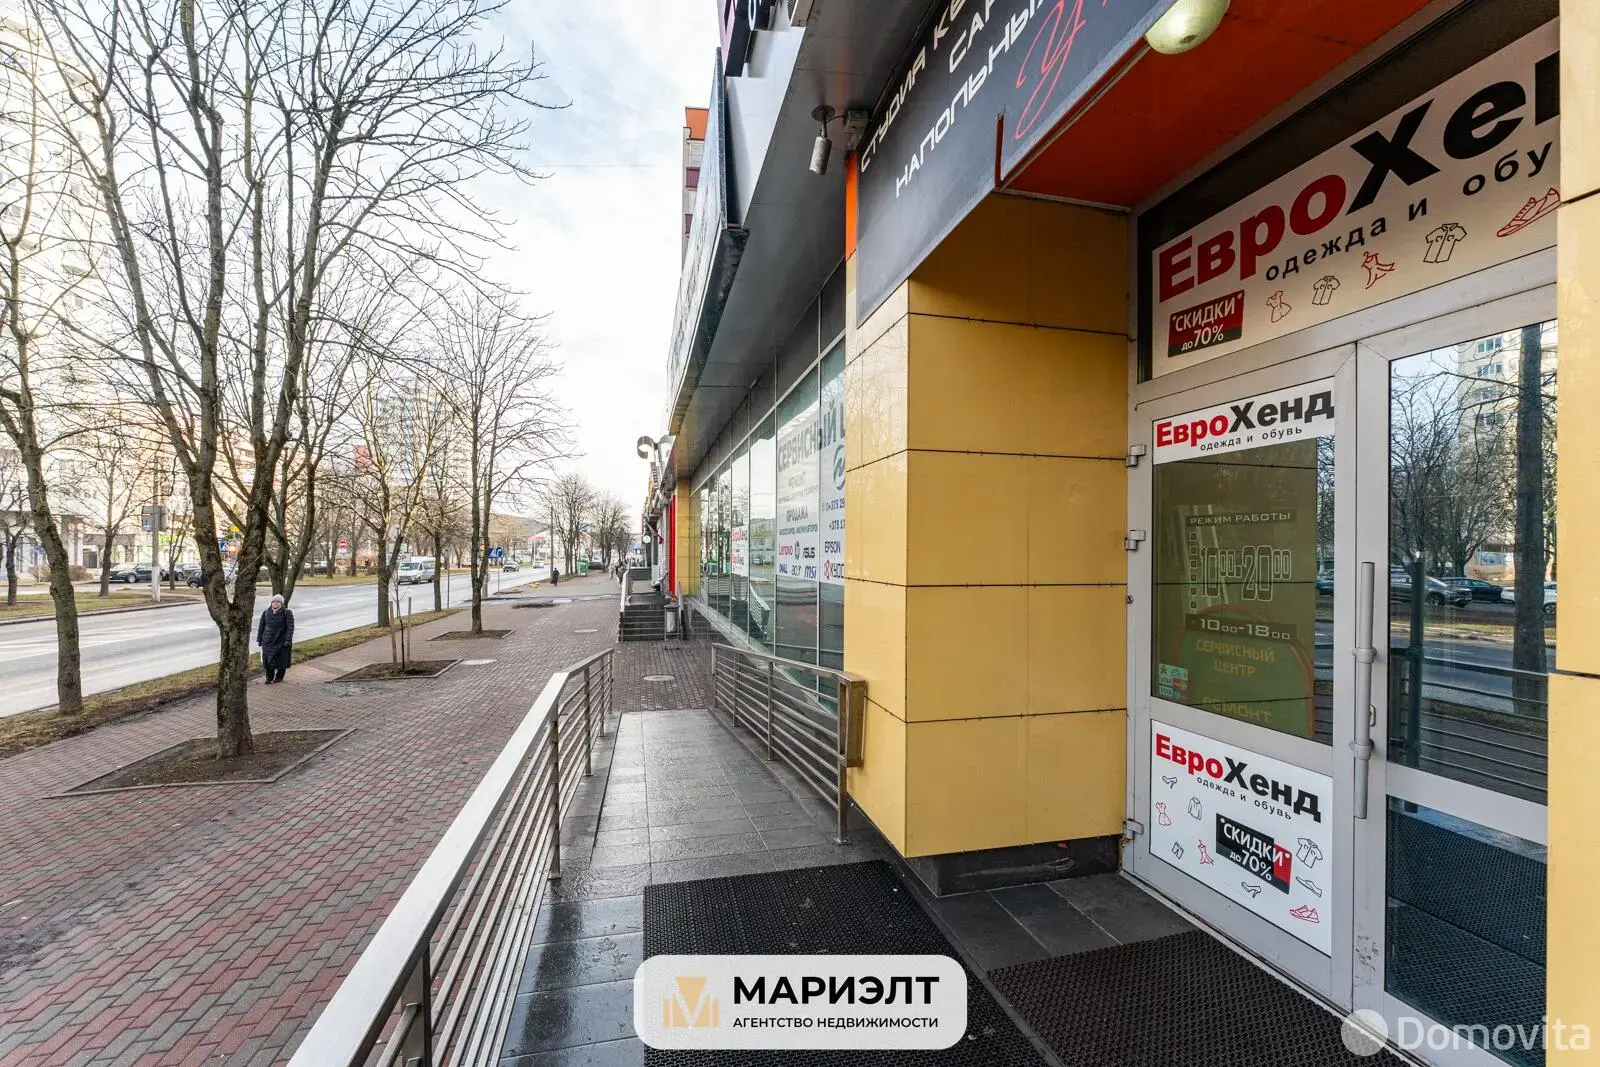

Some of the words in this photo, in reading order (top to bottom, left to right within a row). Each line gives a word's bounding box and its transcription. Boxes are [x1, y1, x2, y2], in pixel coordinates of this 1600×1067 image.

[861, 46, 926, 173] СТУДИЯ
[896, 0, 1044, 199] НАПОЛЬНЫ
[1265, 218, 1387, 281] одежда
[1408, 198, 1427, 222] и
[1175, 297, 1236, 332] СКИДКИ
[1156, 390, 1335, 448] ЕвроХенд
[1200, 437, 1242, 451] одежда
[1247, 435, 1253, 443] и
[1262, 426, 1303, 441] обувь
[1190, 517, 1231, 525] РЕЖИМ
[1235, 512, 1291, 521] РАБОТЫ
[824, 541, 841, 553] EPSON
[1197, 640, 1275, 662] СЕРВИСНЫЙ
[1214, 659, 1256, 676] ЦЕНТР
[1156, 733, 1321, 823] ЕвроХенд
[1197, 776, 1235, 798] одежда
[1254, 799, 1291, 820] обувь
[1223, 823, 1283, 867] СКИДКИ
